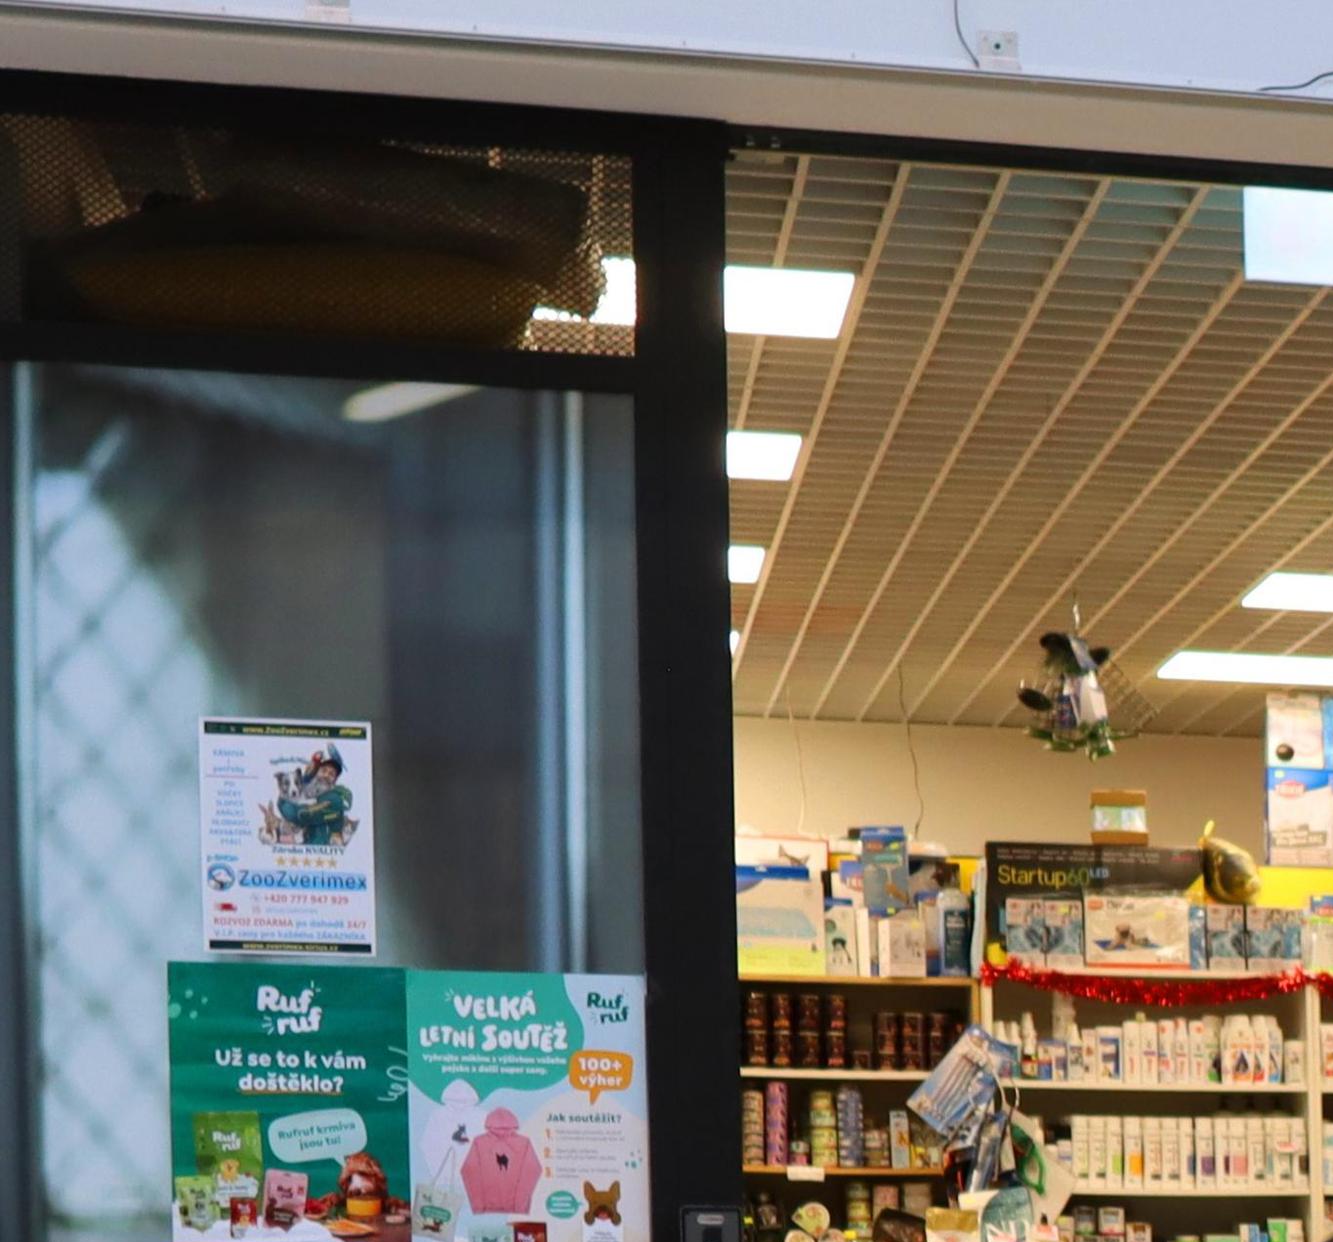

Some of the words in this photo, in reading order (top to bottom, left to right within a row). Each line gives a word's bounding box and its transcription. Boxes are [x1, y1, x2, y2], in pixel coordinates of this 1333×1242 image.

[239, 870, 367, 890] ZooZverimex
[257, 985, 314, 1014] Ruf
[454, 990, 536, 1021] VELKÁ
[586, 991, 624, 1010] Ruf
[277, 1006, 323, 1035] ruf
[600, 1006, 629, 1025] ruf
[419, 1025, 475, 1049] LETNÍ
[481, 1021, 568, 1053] SOUTĚŽ
[215, 1048, 243, 1067] Už
[247, 1054, 272, 1067] se
[276, 1051, 300, 1068] to
[304, 1051, 318, 1069] k
[321, 1050, 367, 1070] vám
[578, 1058, 622, 1073] 100+
[238, 1073, 344, 1093] doštěklo?
[578, 1073, 622, 1087] výher
[546, 1114, 566, 1123] Jak
